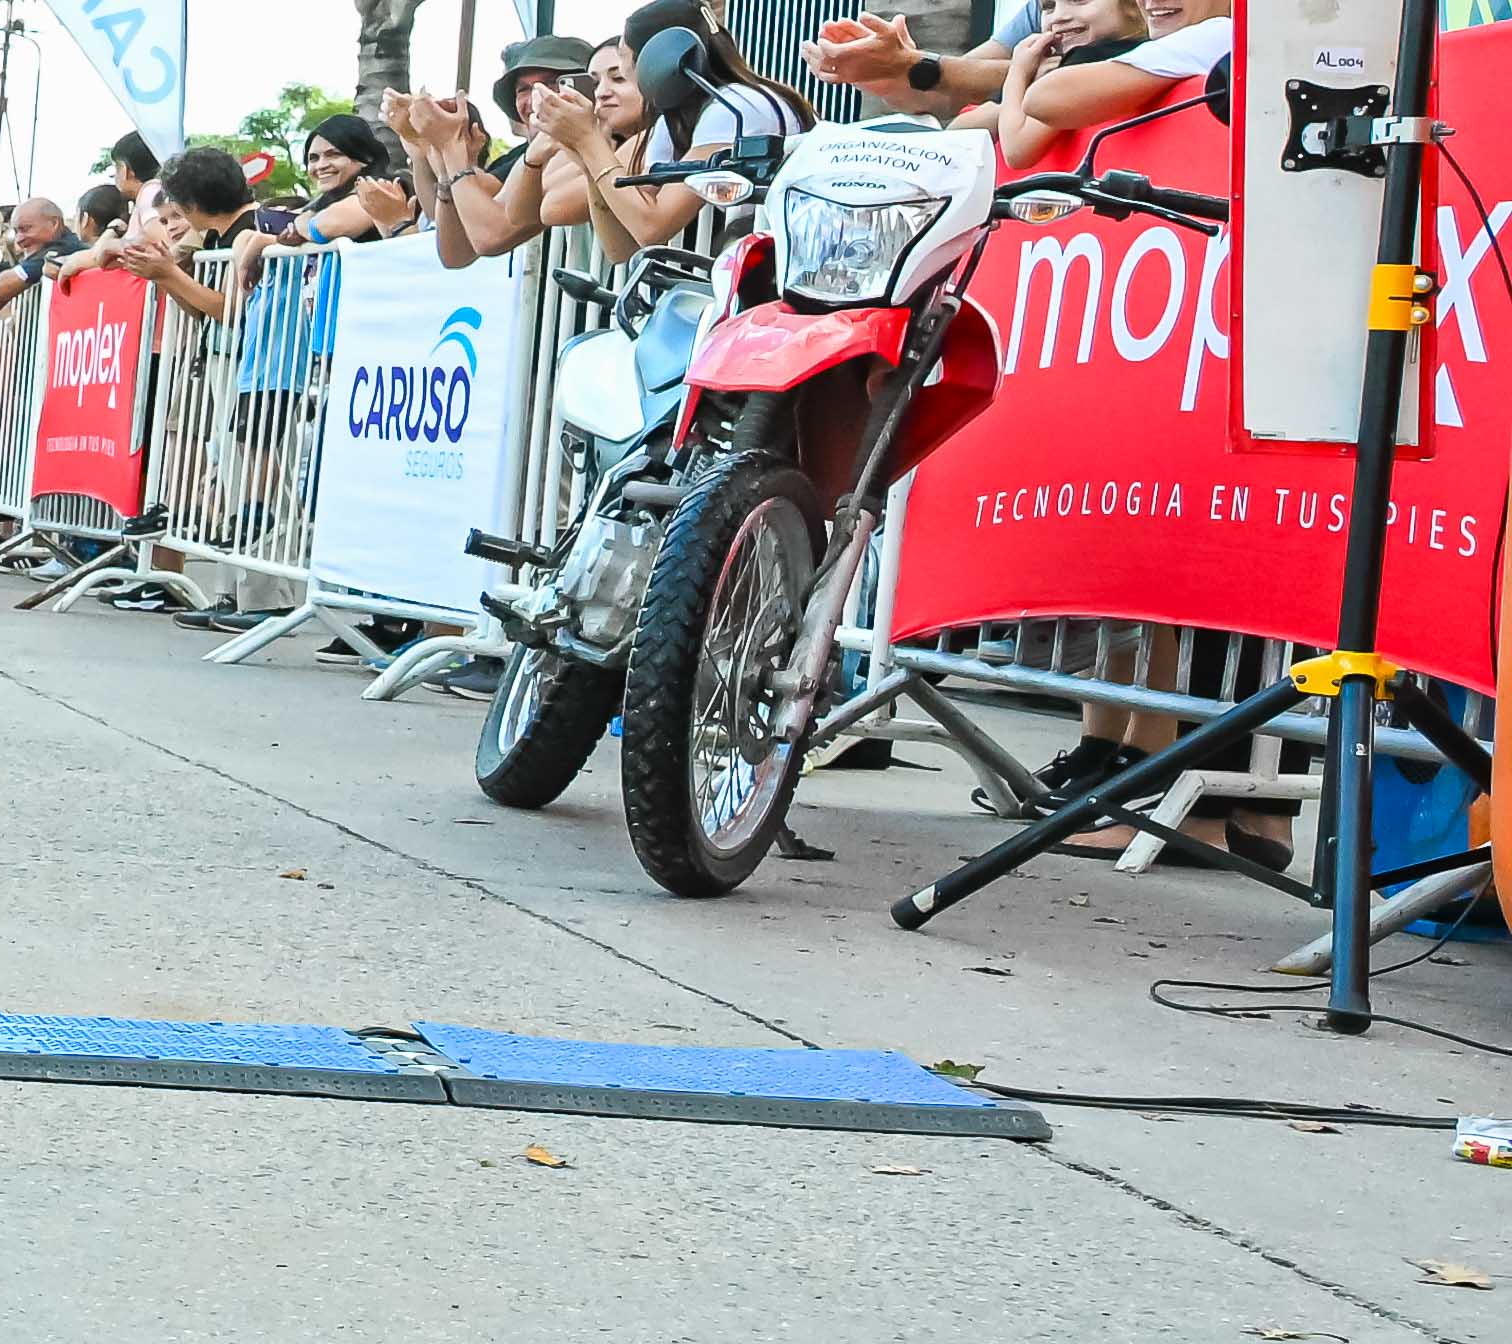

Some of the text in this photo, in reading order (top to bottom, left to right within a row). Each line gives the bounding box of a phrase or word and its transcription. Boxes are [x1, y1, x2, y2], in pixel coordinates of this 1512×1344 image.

[831, 181, 888, 190] HONDA
[1004, 200, 1512, 412] mopx
[52, 301, 128, 408] moplex
[349, 366, 471, 444] CARUSO
[974, 480, 1183, 528] TECNOLOGIA
[1209, 484, 1249, 522] EN
[1275, 488, 1346, 533] TUS
